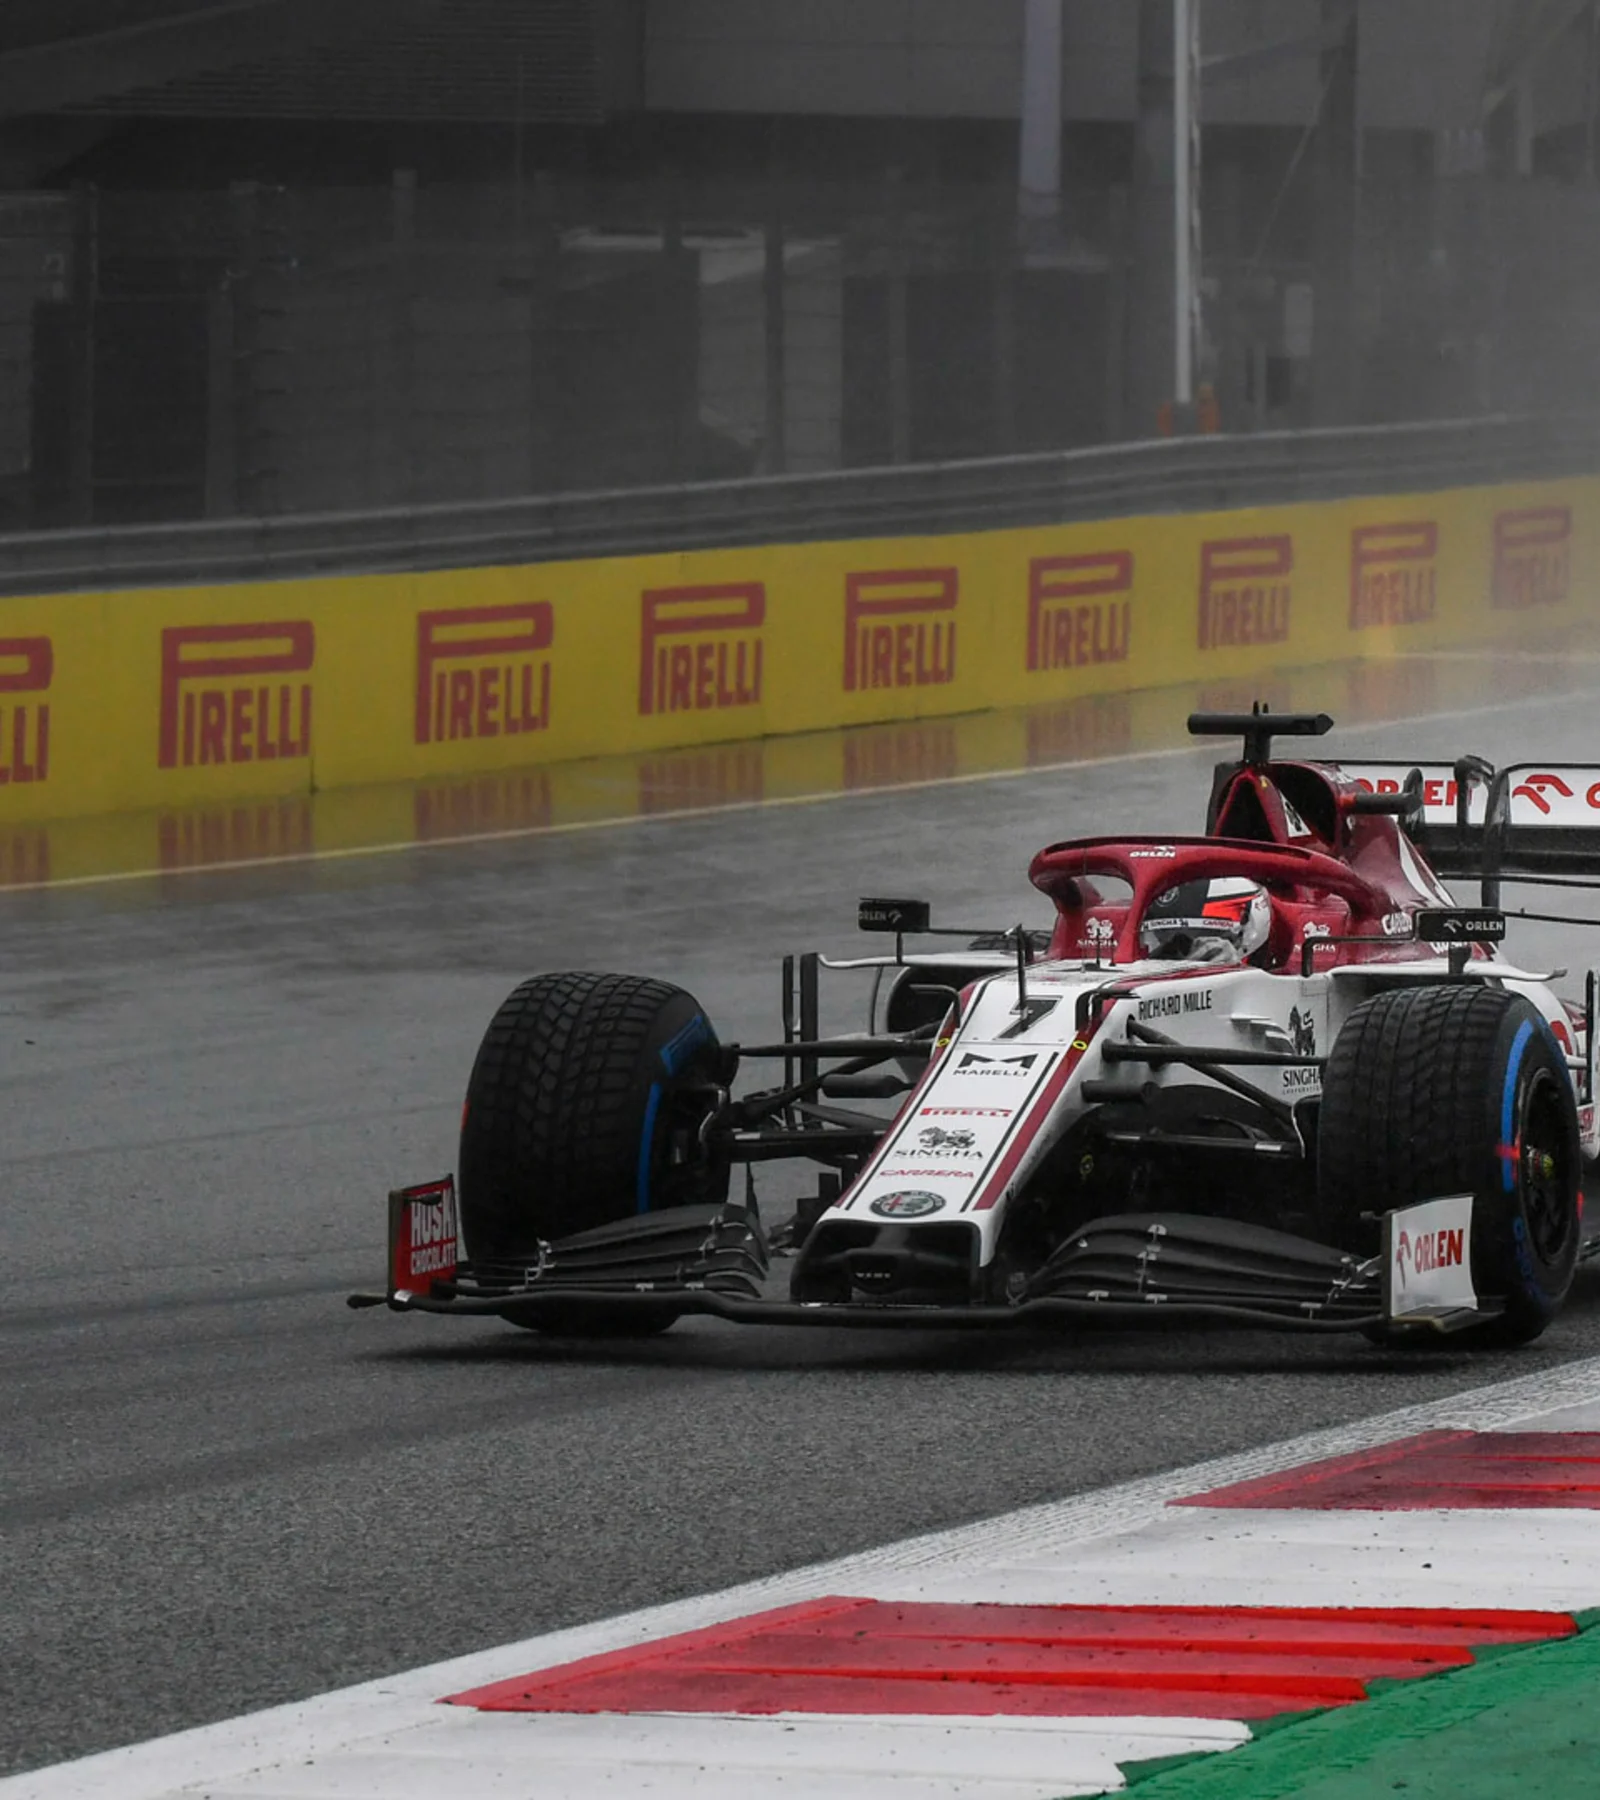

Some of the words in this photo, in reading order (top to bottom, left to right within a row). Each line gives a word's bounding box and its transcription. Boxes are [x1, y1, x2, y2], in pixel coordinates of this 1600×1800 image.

[1026, 550, 1134, 671] PIRELLI
[1197, 533, 1292, 651] PIRELLI
[638, 582, 765, 715] PIRELLI
[843, 567, 959, 692] PIRELLI
[415, 602, 553, 743] PIRELLI
[158, 620, 314, 768] PIRELLI
[1465, 920, 1504, 931] ORLEN
[992, 995, 1063, 1040] 7
[1138, 994, 1180, 1020] RICHARD
[1183, 989, 1213, 1014] MILLE
[953, 1069, 1029, 1077] MARELLI
[1282, 1068, 1320, 1087] SINGH
[920, 1107, 1013, 1117] PIRELLI
[880, 1169, 974, 1178] CARRERA
[893, 1149, 983, 1159] SINGHA
[411, 1241, 457, 1276] CHOCOLATE
[1414, 1228, 1464, 1275] ORLEN
